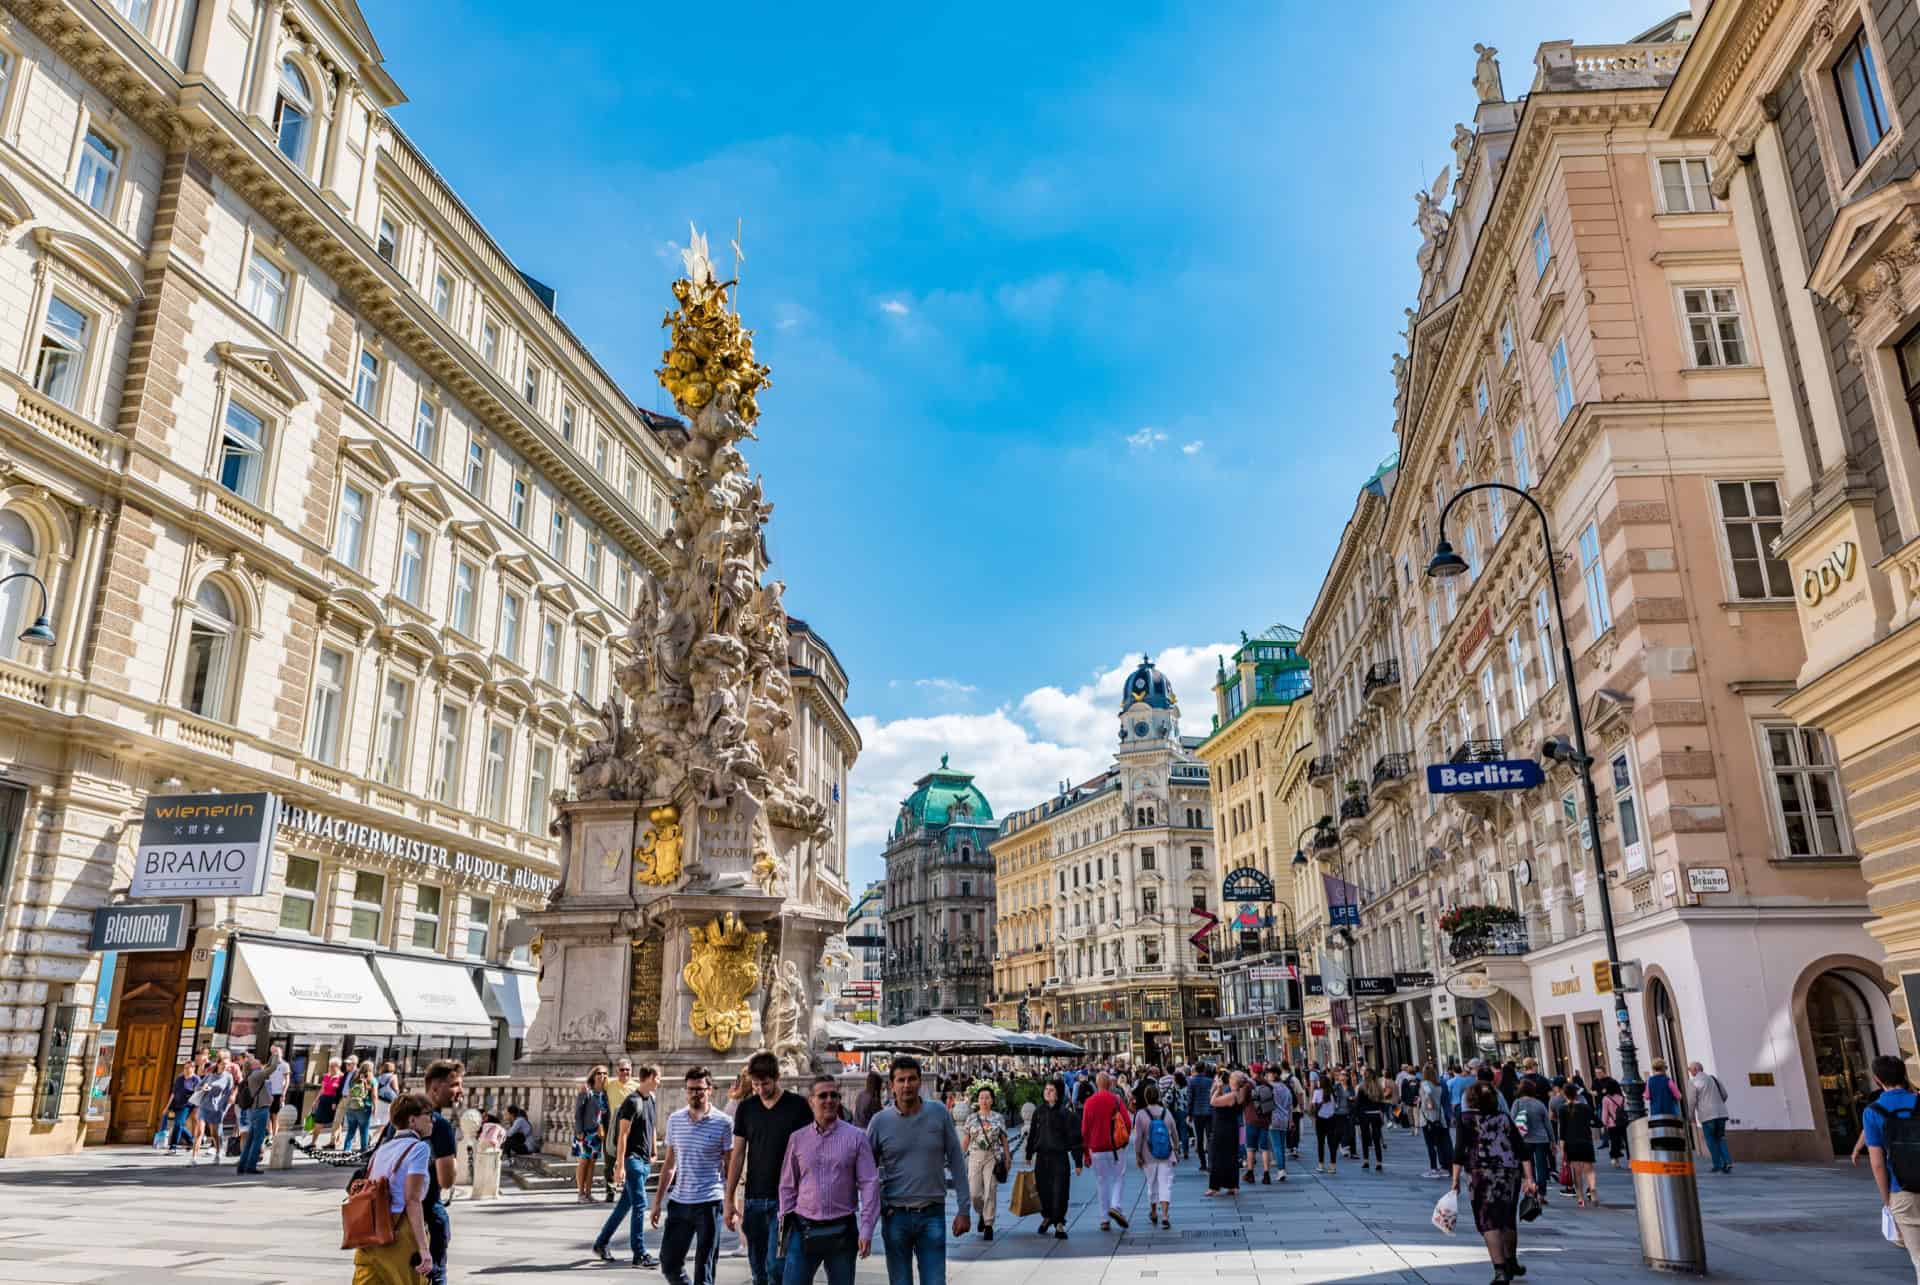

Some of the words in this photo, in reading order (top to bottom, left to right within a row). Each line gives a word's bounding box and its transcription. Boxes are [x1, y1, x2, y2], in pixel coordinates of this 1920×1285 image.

[1799, 541, 1857, 607] ÖBV
[1440, 764, 1524, 787] Berlitz
[155, 802, 254, 819] wienerin
[279, 802, 448, 867] HRMACHERMEISTER
[455, 851, 508, 881] RUDOLF
[145, 849, 246, 874] BRAMO
[146, 878, 239, 889] COIFFEUR
[1360, 979, 1379, 989] IWC
